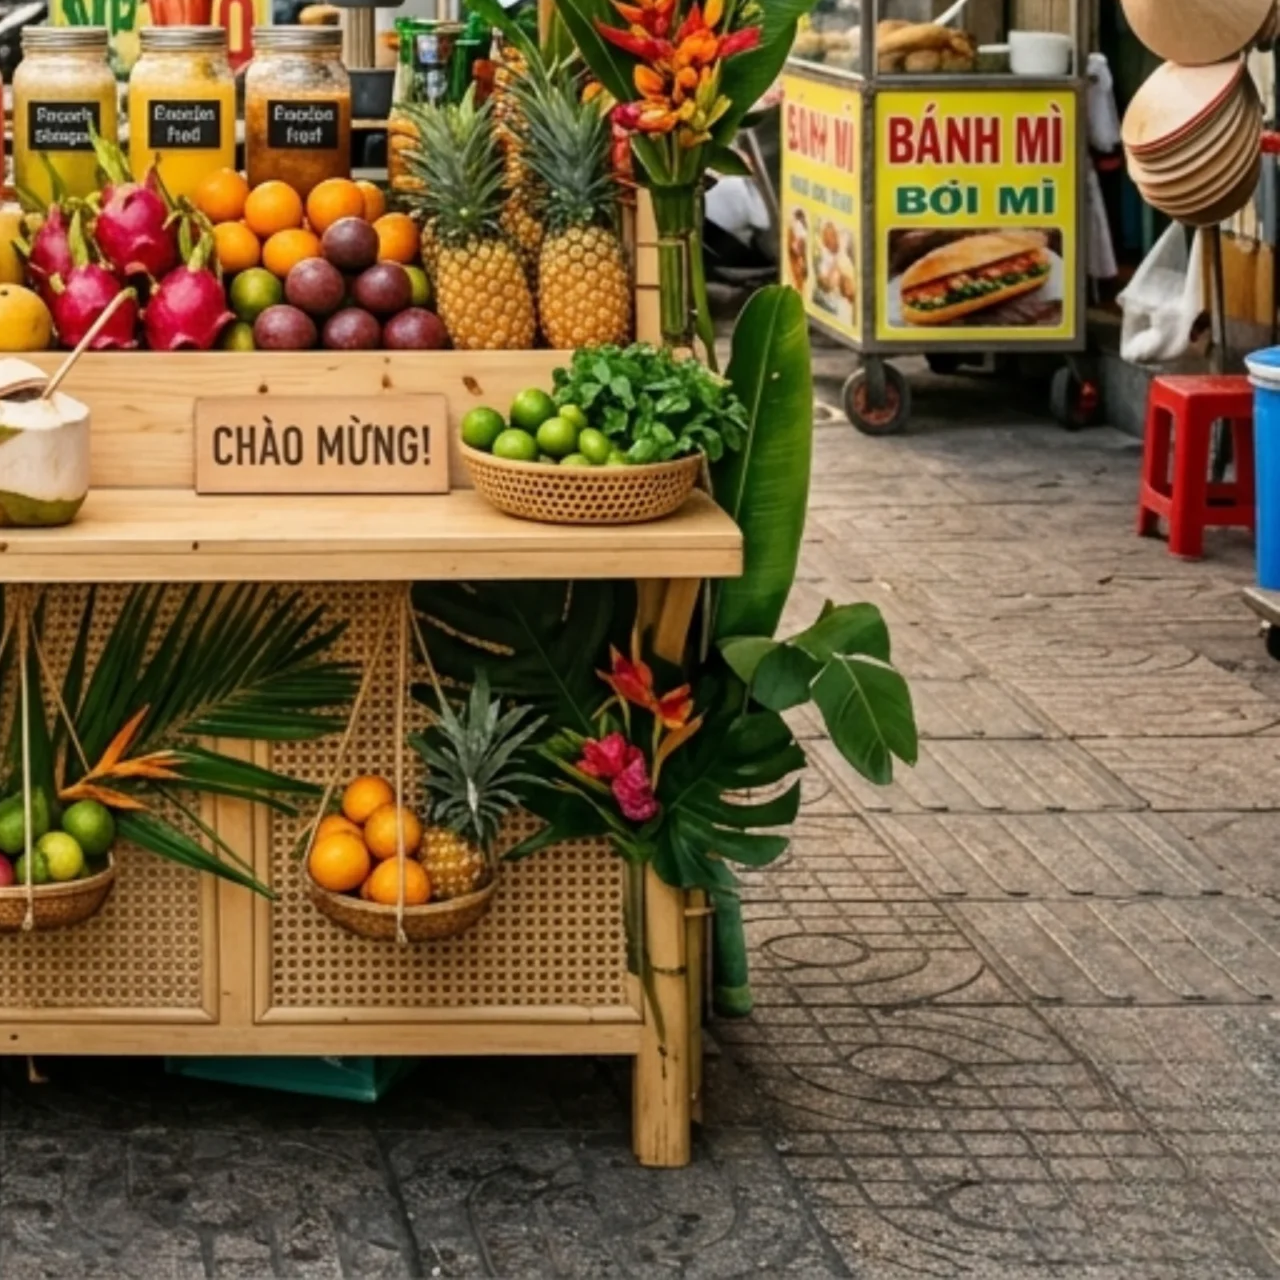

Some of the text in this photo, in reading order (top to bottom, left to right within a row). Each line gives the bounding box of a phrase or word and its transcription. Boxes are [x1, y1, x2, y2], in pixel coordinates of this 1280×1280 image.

[888, 103, 1000, 164] BÁNH
[1016, 103, 1062, 163] MÌ
[213, 415, 431, 466] CHÀO MỪNG!
